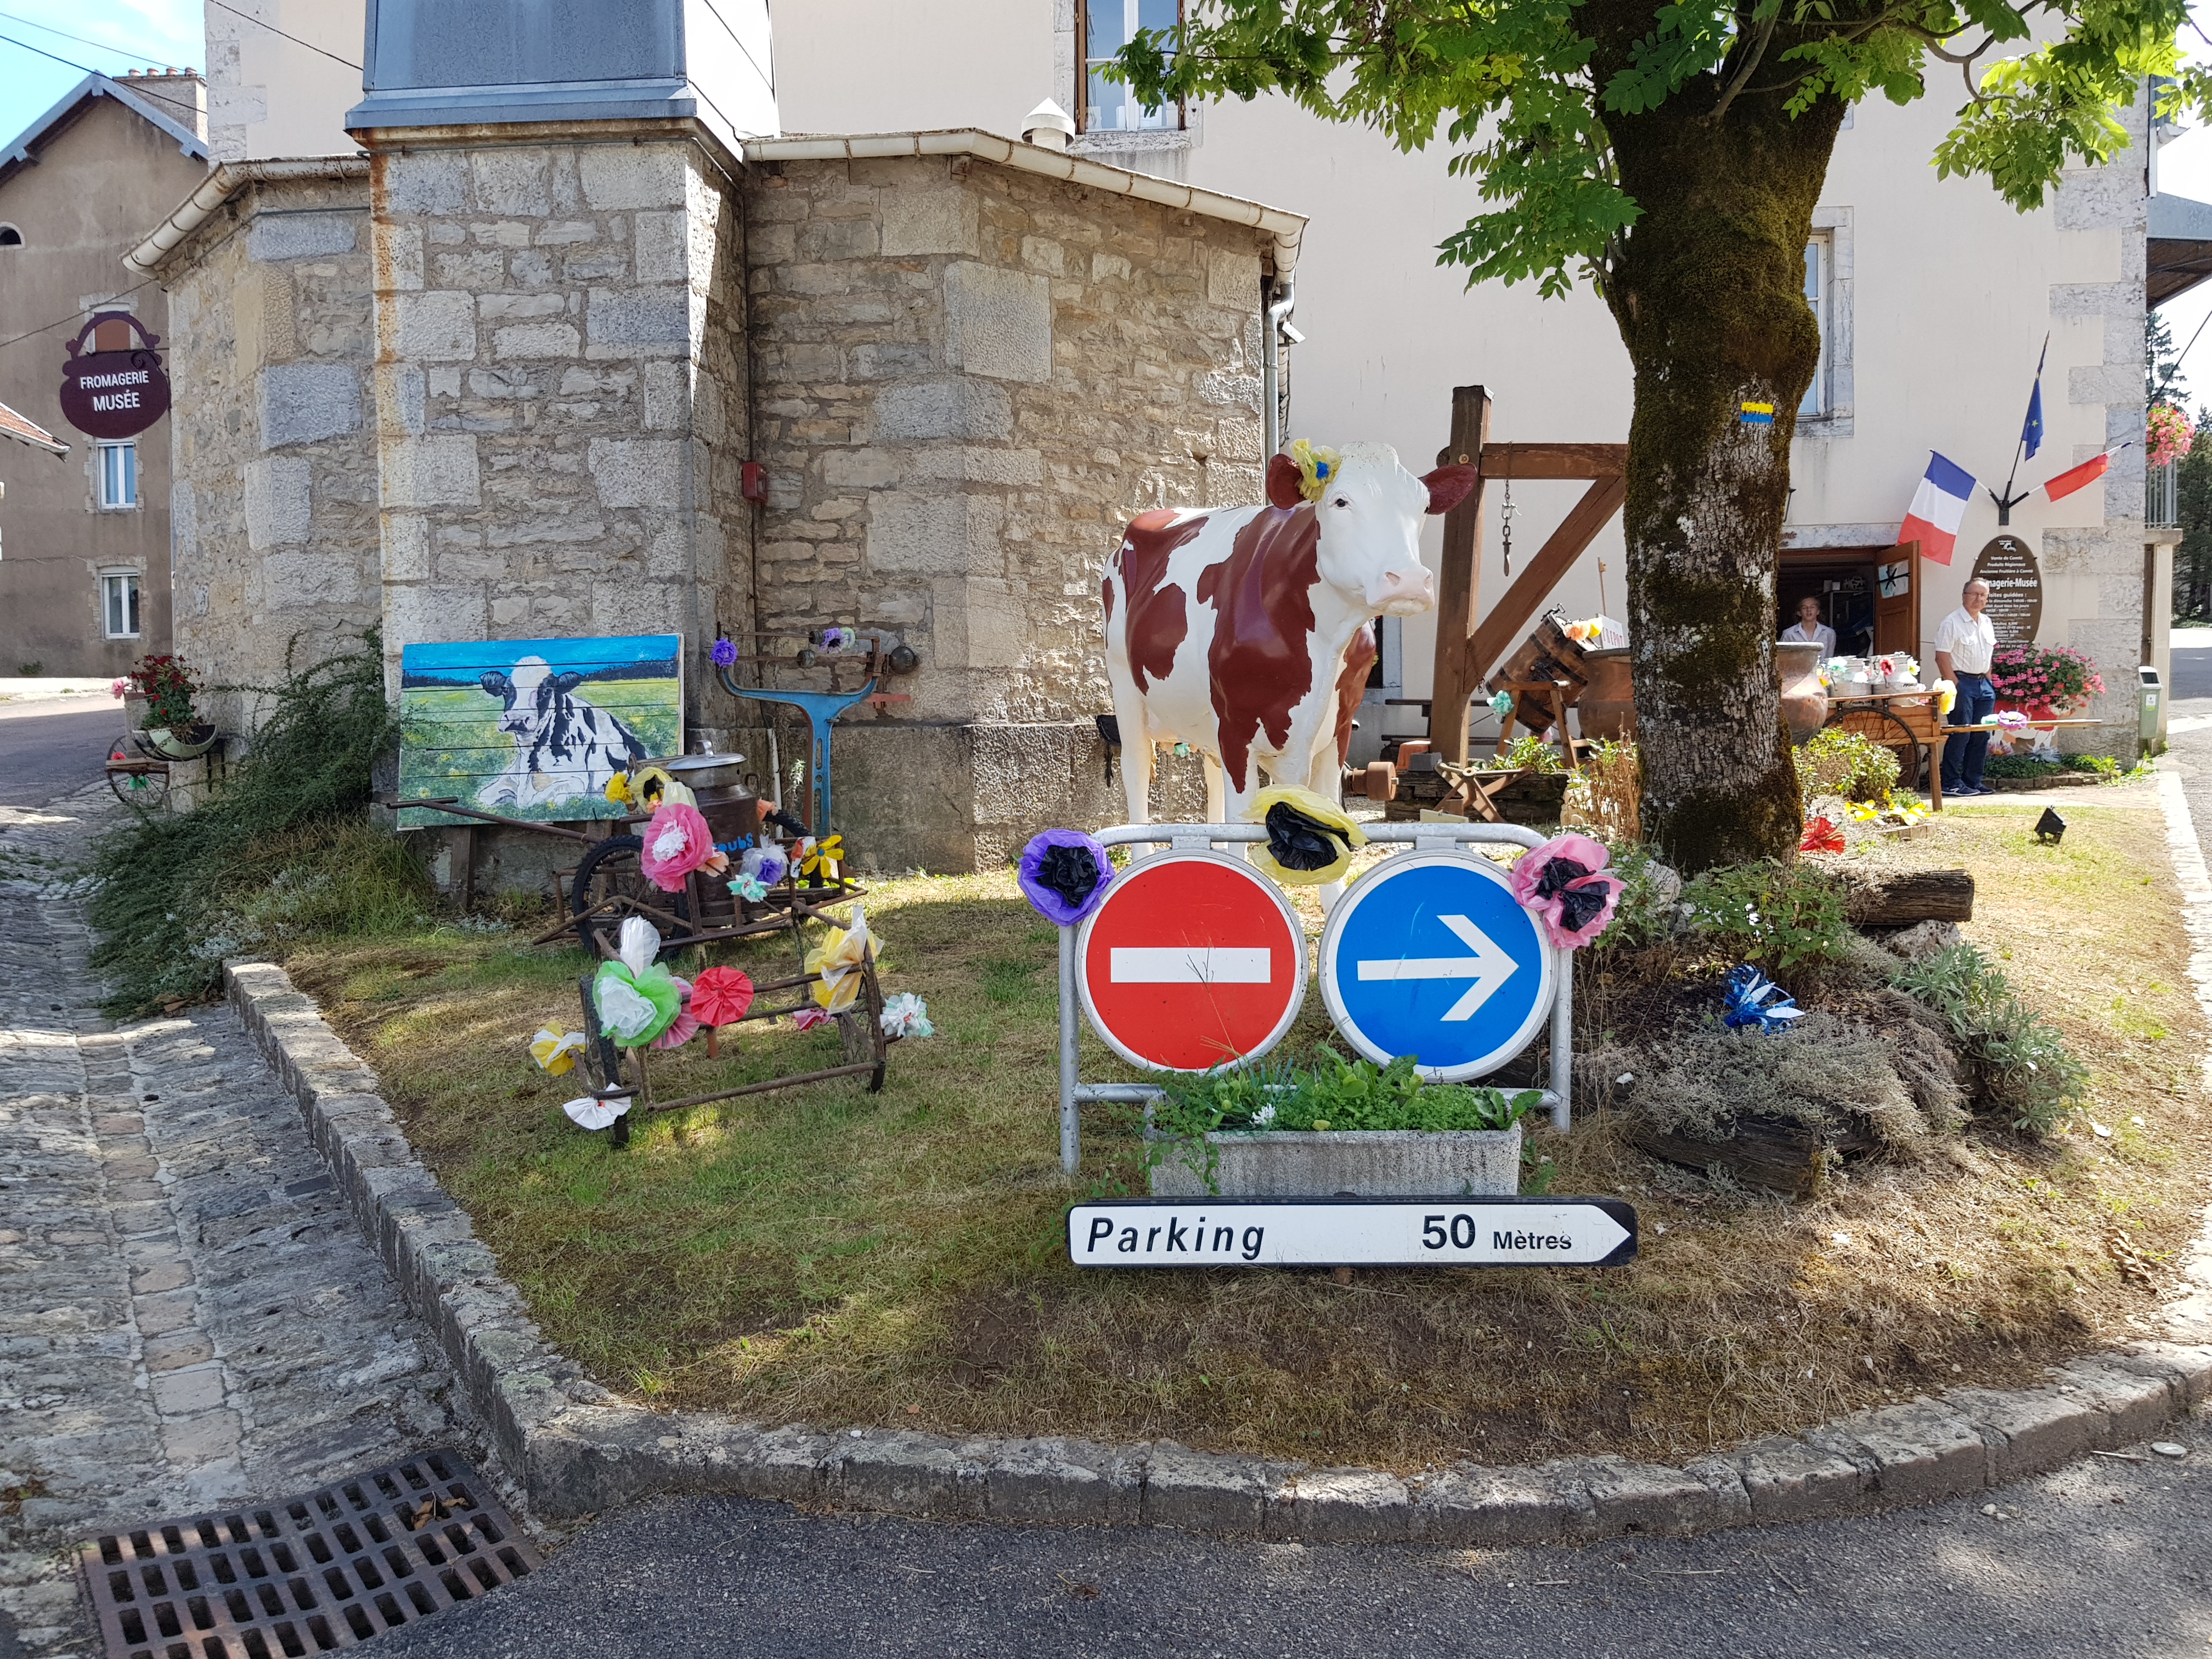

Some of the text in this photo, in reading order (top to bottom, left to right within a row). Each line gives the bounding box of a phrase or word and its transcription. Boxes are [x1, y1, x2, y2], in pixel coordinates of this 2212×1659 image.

[80, 370, 149, 390] FROMAGERIE
[93, 389, 140, 411] MUSÉE
[1987, 578, 2037, 590] magerie-Musée
[1087, 1214, 1572, 1260] Parking 50 Mètres
